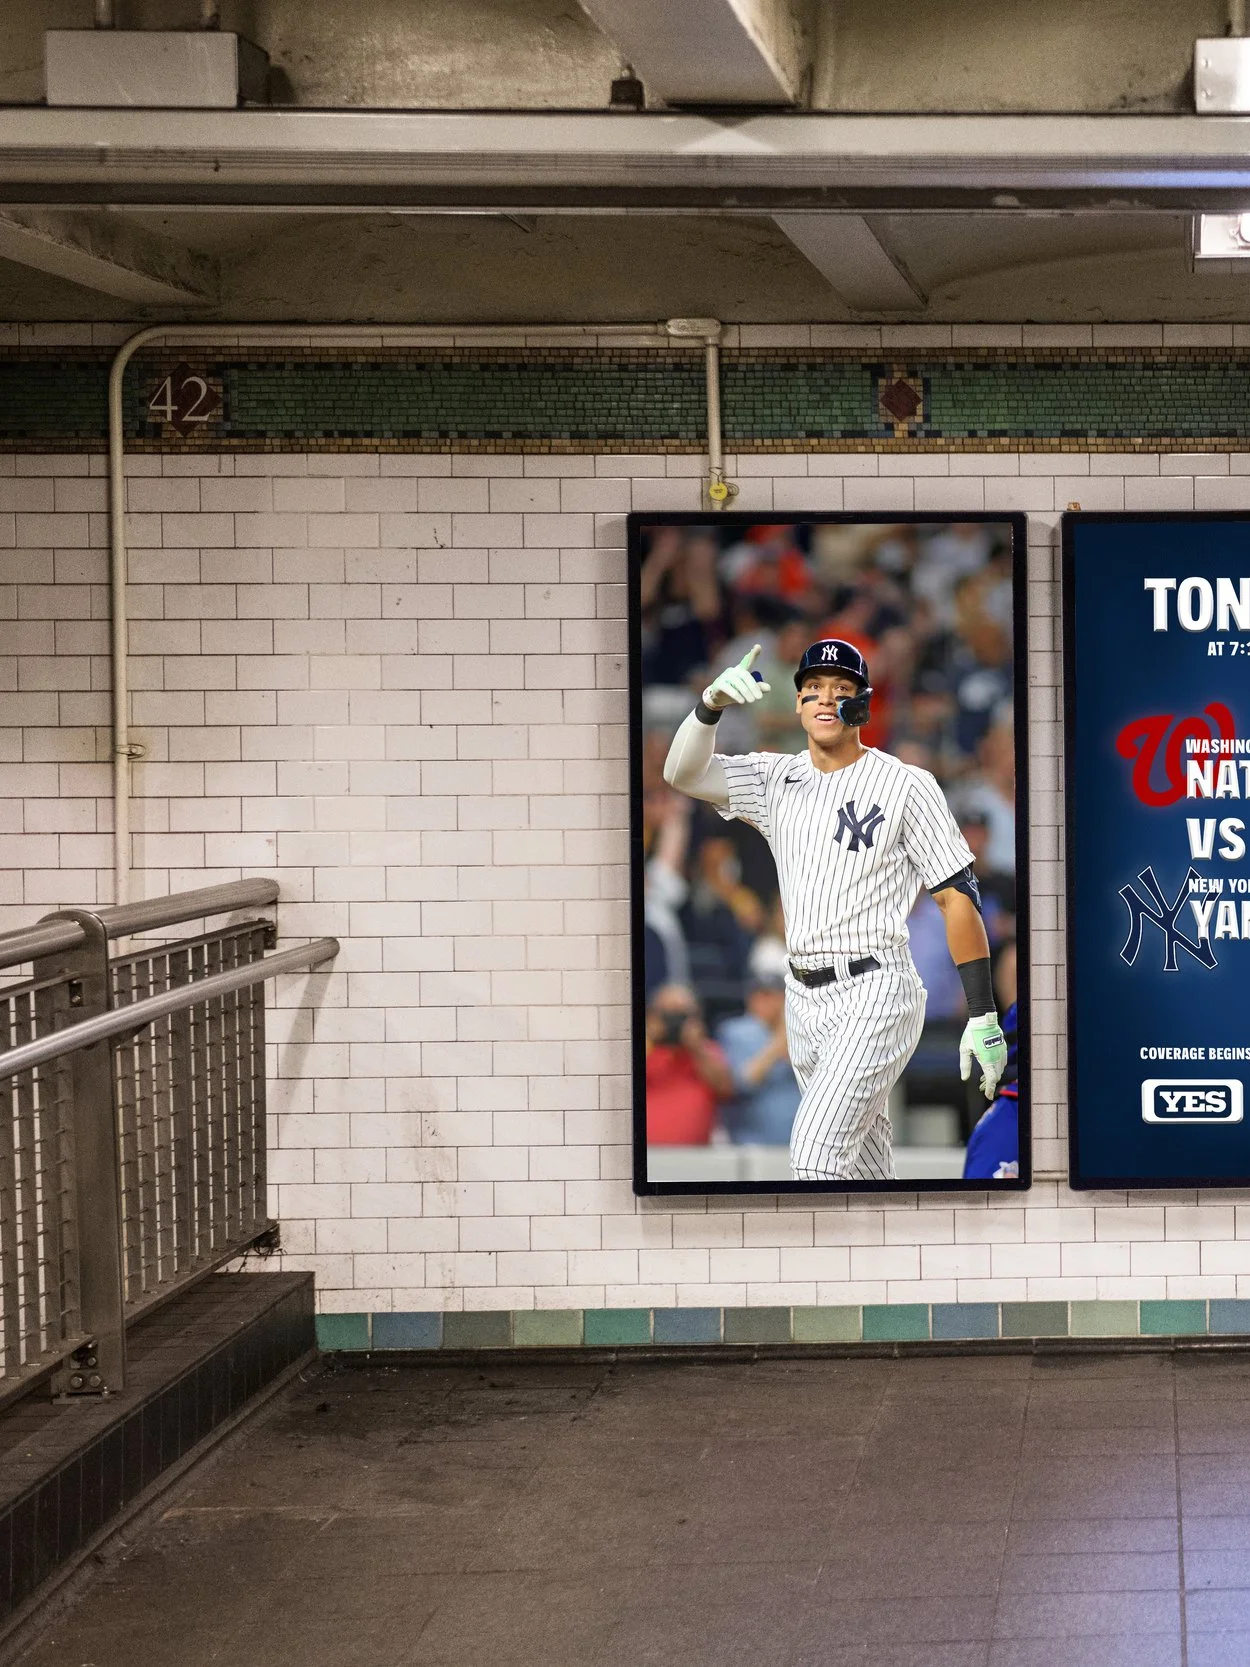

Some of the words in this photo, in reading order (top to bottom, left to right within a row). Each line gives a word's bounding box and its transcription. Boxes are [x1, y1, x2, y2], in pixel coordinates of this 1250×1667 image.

[149, 376, 211, 421] 42
[821, 644, 838, 661] NY
[1207, 641, 1225, 656] AT
[833, 800, 886, 852] NY
[1186, 817, 1247, 861] VS
[1188, 878, 1223, 893] NEW
[1140, 1047, 1205, 1060] COVERAGE
[1159, 1091, 1227, 1113] YES
